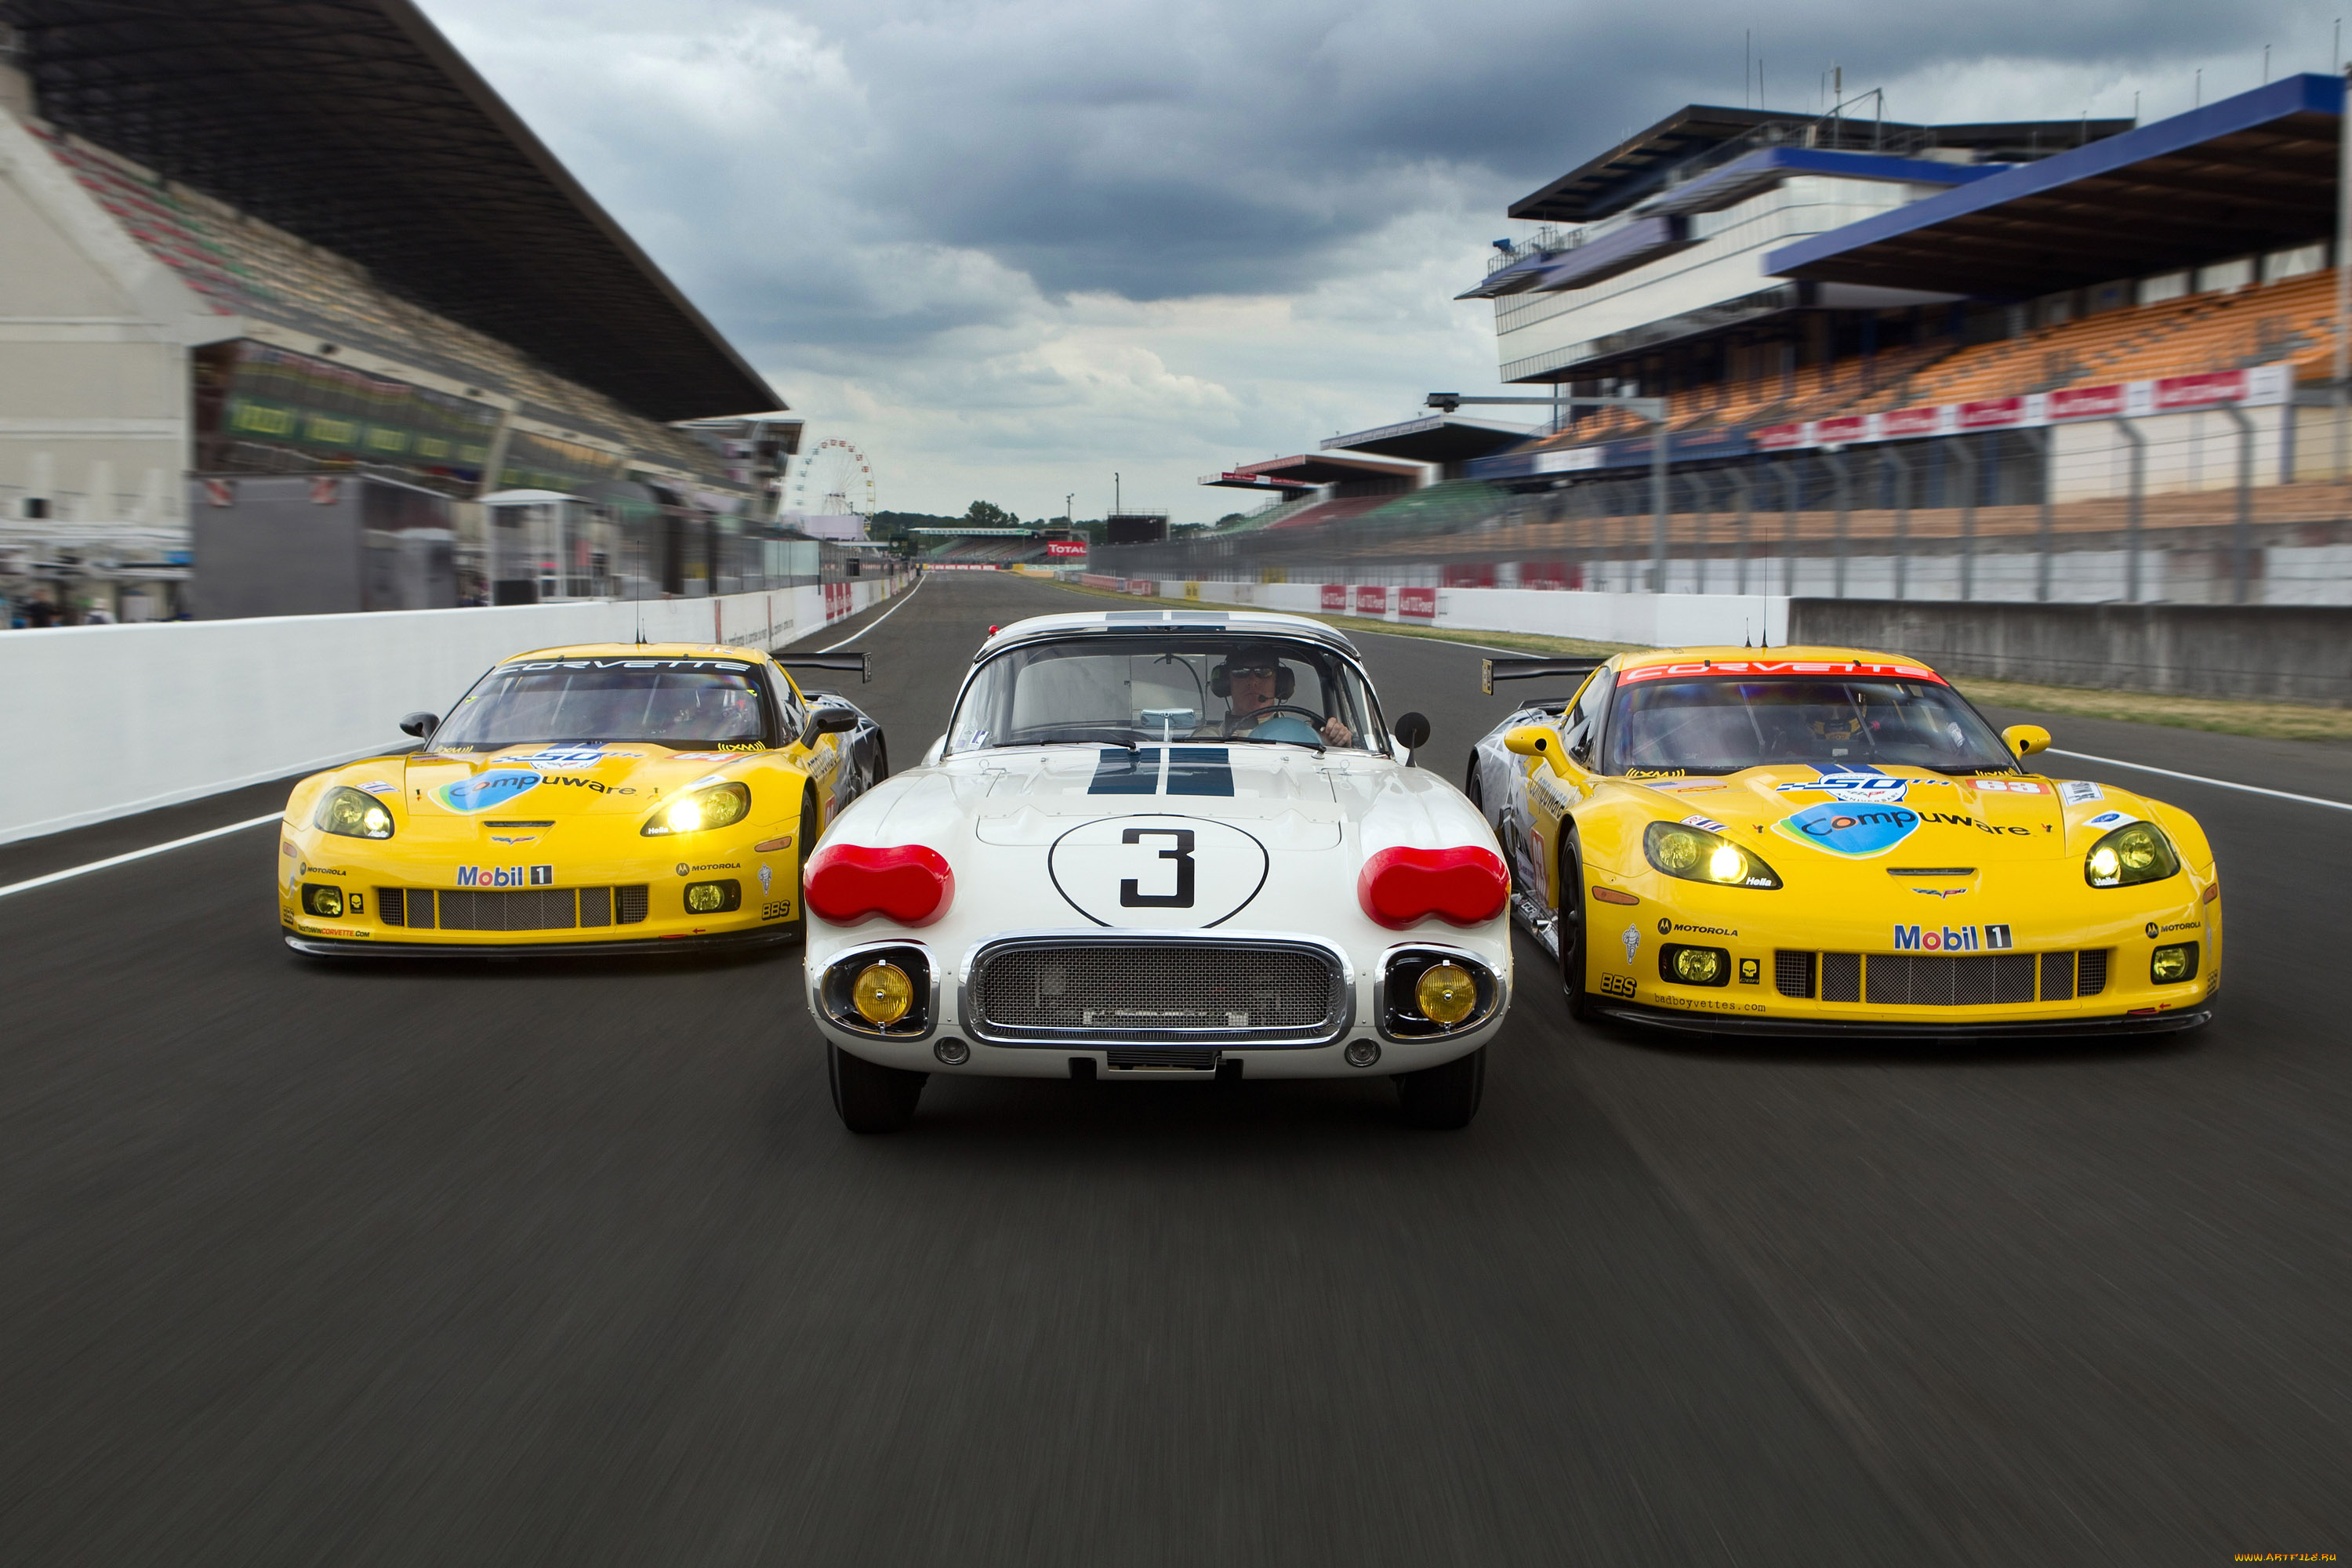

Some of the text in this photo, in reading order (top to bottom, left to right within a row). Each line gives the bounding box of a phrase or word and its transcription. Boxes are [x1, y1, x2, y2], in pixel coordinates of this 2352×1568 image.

[1048, 543, 1087, 554] TOTAL
[492, 659, 752, 676] CORVETTE
[1626, 661, 1929, 679] CORVETTE
[1975, 779, 2041, 794] 63
[307, 866, 347, 876] MOTOROLA
[691, 862, 741, 872] MOTOROLA
[1120, 828, 1195, 908] 3
[457, 866, 523, 887] Mobil
[1745, 877, 1772, 887] Hella
[761, 899, 791, 920] BBS
[1673, 924, 1739, 937] MOTOROLA
[2160, 921, 2201, 933] MOTOROLA
[1894, 924, 1979, 951] Mobil
[1600, 972, 1638, 999] BBS
[1654, 993, 1766, 1012] badboyvettes.com
